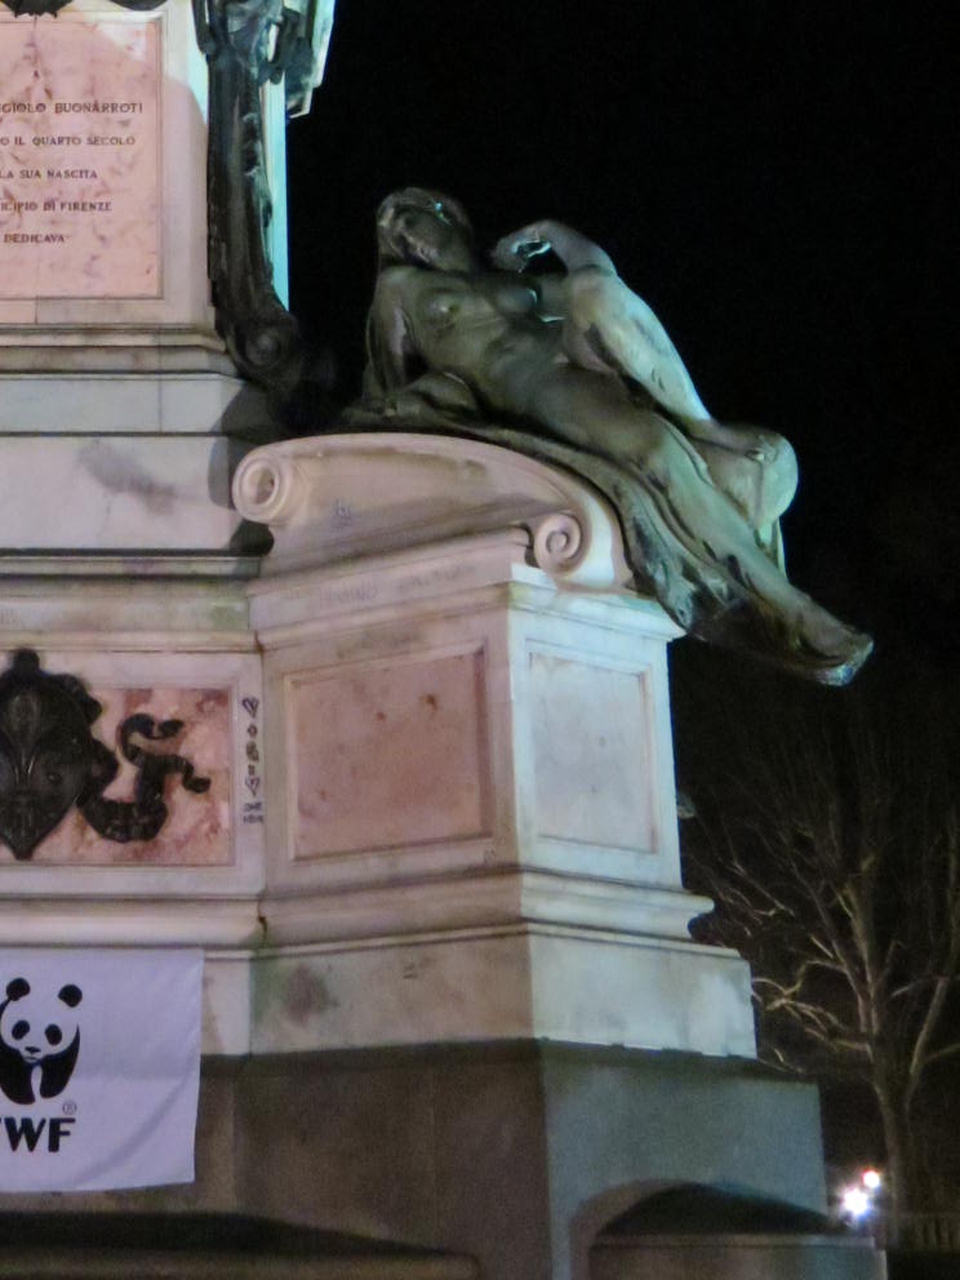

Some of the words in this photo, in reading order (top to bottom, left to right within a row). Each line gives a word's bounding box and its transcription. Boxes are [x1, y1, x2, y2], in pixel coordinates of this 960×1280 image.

[54, 102, 143, 114] BUONARROTI
[14, 136, 26, 146] IL
[32, 136, 82, 147] QUARTO
[86, 135, 136, 146] SECOLO
[20, 169, 42, 179] SUA
[47, 169, 98, 179] NASCITA
[43, 201, 56, 212] DI
[60, 201, 113, 212] FIRENZE
[3, 233, 65, 243] DEDICAVA
